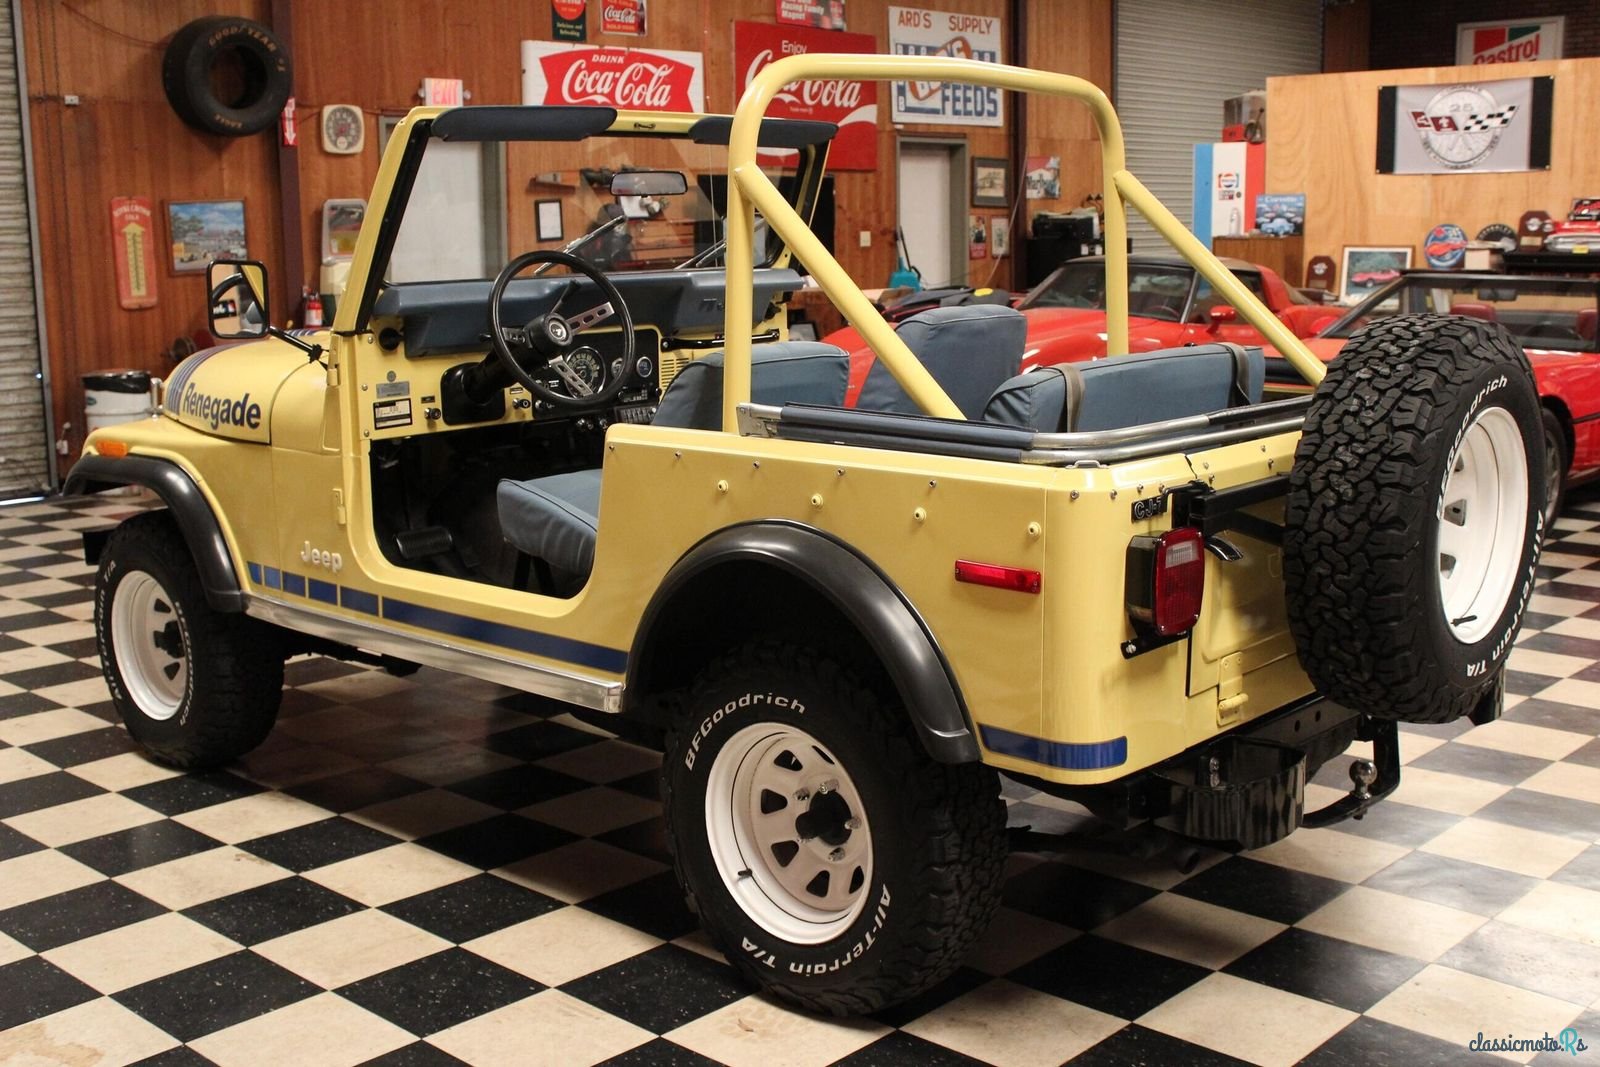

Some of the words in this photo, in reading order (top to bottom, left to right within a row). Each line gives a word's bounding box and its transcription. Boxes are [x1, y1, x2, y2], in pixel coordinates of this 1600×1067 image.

[781, 11, 806, 19] Magnet
[804, 5, 825, 15] Family
[898, 10, 932, 29] ARD'S
[948, 15, 993, 34] SUPPLY
[592, 54, 625, 64] DRINK
[782, 40, 807, 54] Enjoy
[561, 59, 675, 107] Coca-Cola
[941, 82, 998, 117] FEEDS
[1449, 103, 1474, 113] 25
[183, 382, 261, 431] Renegade
[1134, 497, 1163, 519] CJ-7
[300, 540, 343, 574] Jeep
[1492, 509, 1545, 662] All-Terrain
[1466, 660, 1488, 678] T/A
[684, 692, 806, 772] BFGoodrich
[788, 883, 892, 978] All-Terrain
[740, 936, 776, 970] T/A
